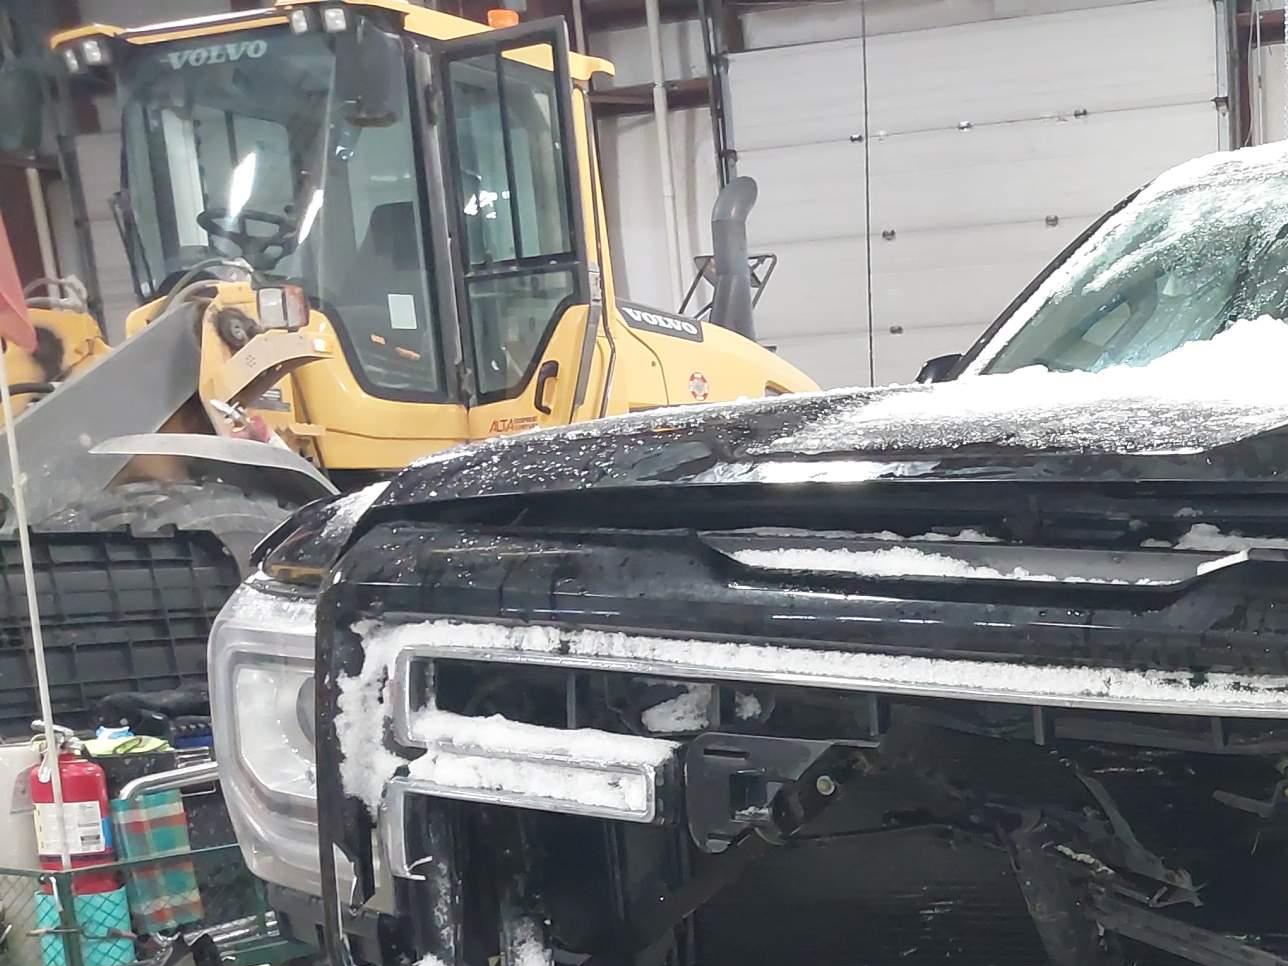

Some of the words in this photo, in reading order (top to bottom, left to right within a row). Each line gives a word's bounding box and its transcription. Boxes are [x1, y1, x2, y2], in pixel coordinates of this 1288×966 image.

[167, 39, 268, 70] VOLVO
[621, 307, 698, 335] VOLVO
[489, 418, 513, 432] ALTA
